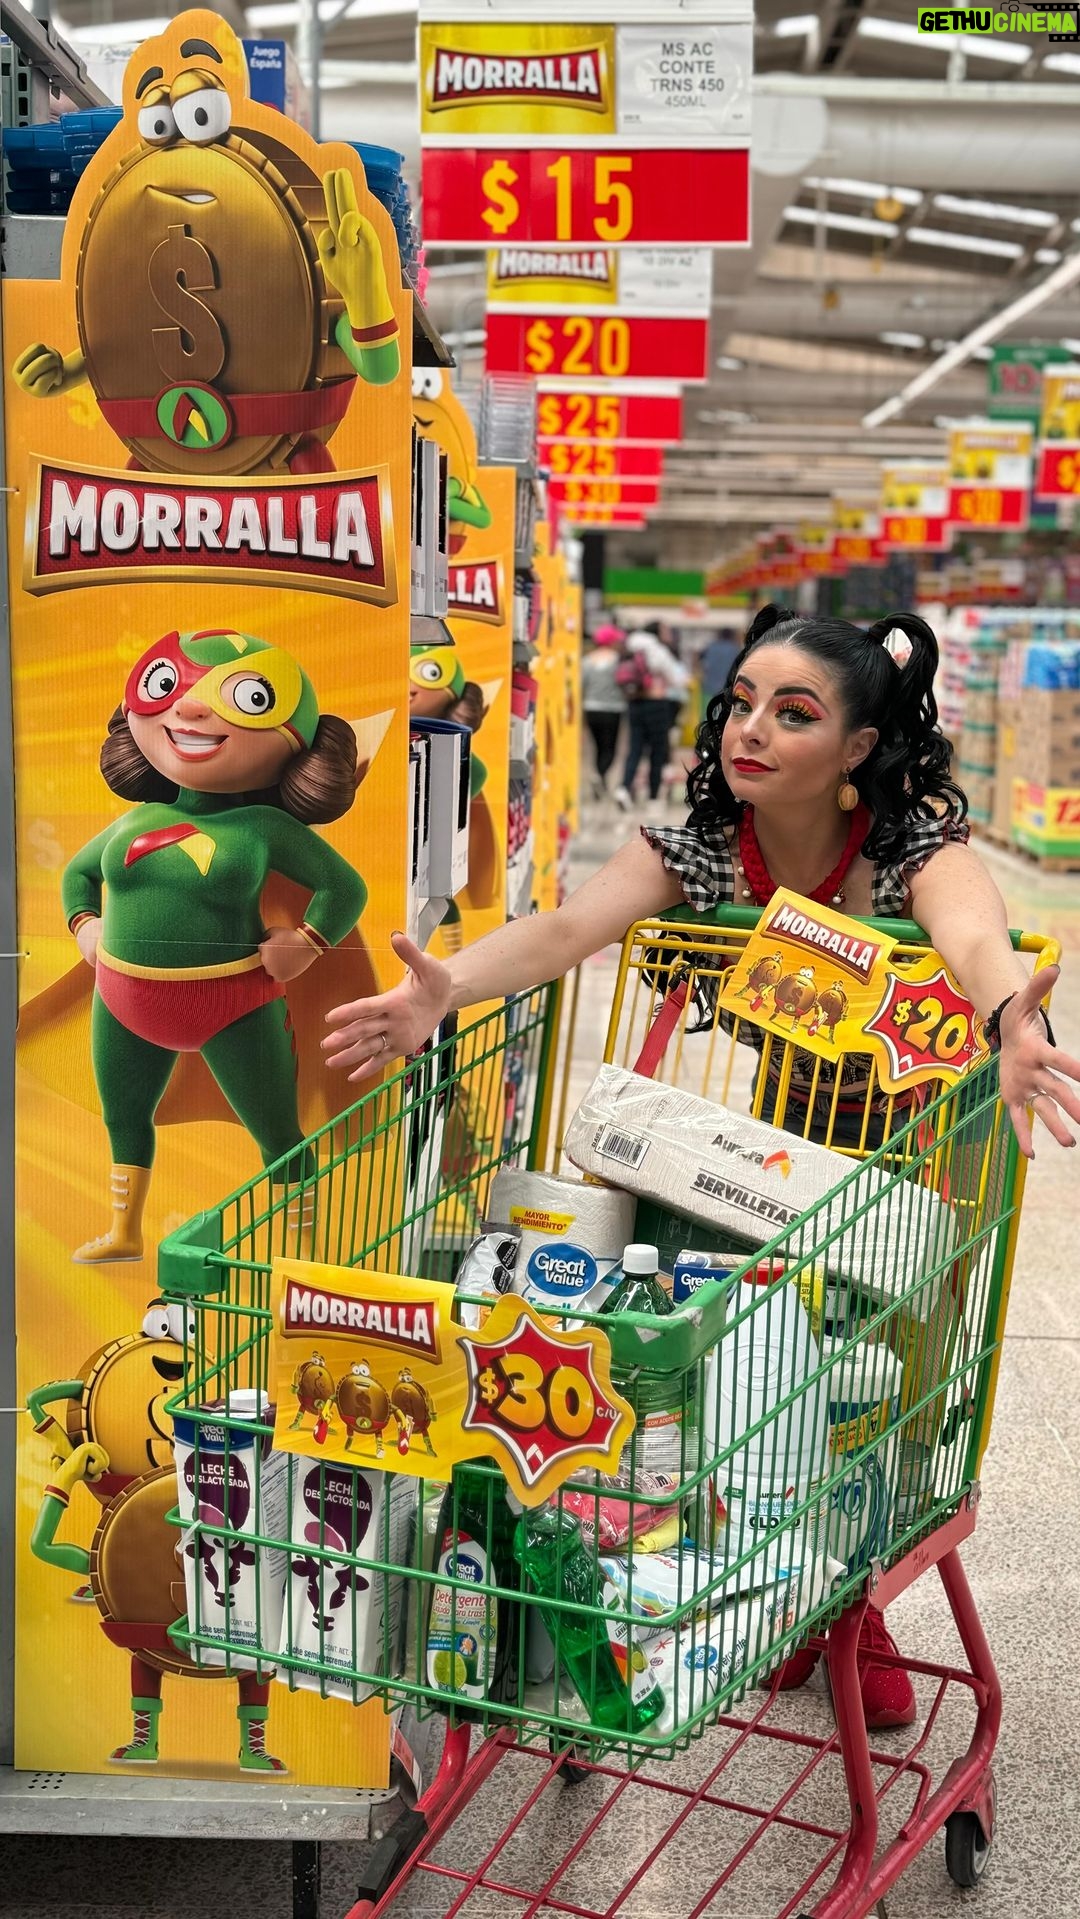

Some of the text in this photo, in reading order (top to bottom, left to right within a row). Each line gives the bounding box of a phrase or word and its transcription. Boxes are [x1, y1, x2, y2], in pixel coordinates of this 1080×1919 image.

[252, 46, 281, 58] Juego
[661, 42, 713, 56] MS AC
[249, 57, 282, 70] España
[659, 60, 715, 74] CONTE
[437, 53, 599, 96] MORRALLA
[650, 78, 724, 92] TRNS 450
[664, 95, 707, 108] 450ML
[500, 249, 608, 278] MORRALLA
[526, 316, 630, 376] $20
[538, 393, 620, 439] $25
[49, 479, 375, 566] MORRALLA
[772, 905, 873, 972] MORRALLA
[893, 996, 969, 1060] $20
[693, 1173, 801, 1226] SERVILLETAS
[525, 1210, 550, 1221] MAYOR
[535, 1252, 586, 1277] Great
[545, 1270, 584, 1287] Value
[681, 1273, 714, 1287] Gre
[288, 1286, 431, 1346] MORRALLA
[478, 1353, 595, 1439] $30
[596, 1407, 618, 1420] C/U
[204, 1432, 226, 1442] Valu
[201, 1463, 235, 1477] LECHE
[324, 1480, 355, 1497] ECH
[305, 1488, 371, 1511] DESACTOSDA
[456, 1571, 475, 1582] alue
[436, 1589, 492, 1609] Detegent
[468, 1609, 495, 1618] trasts
